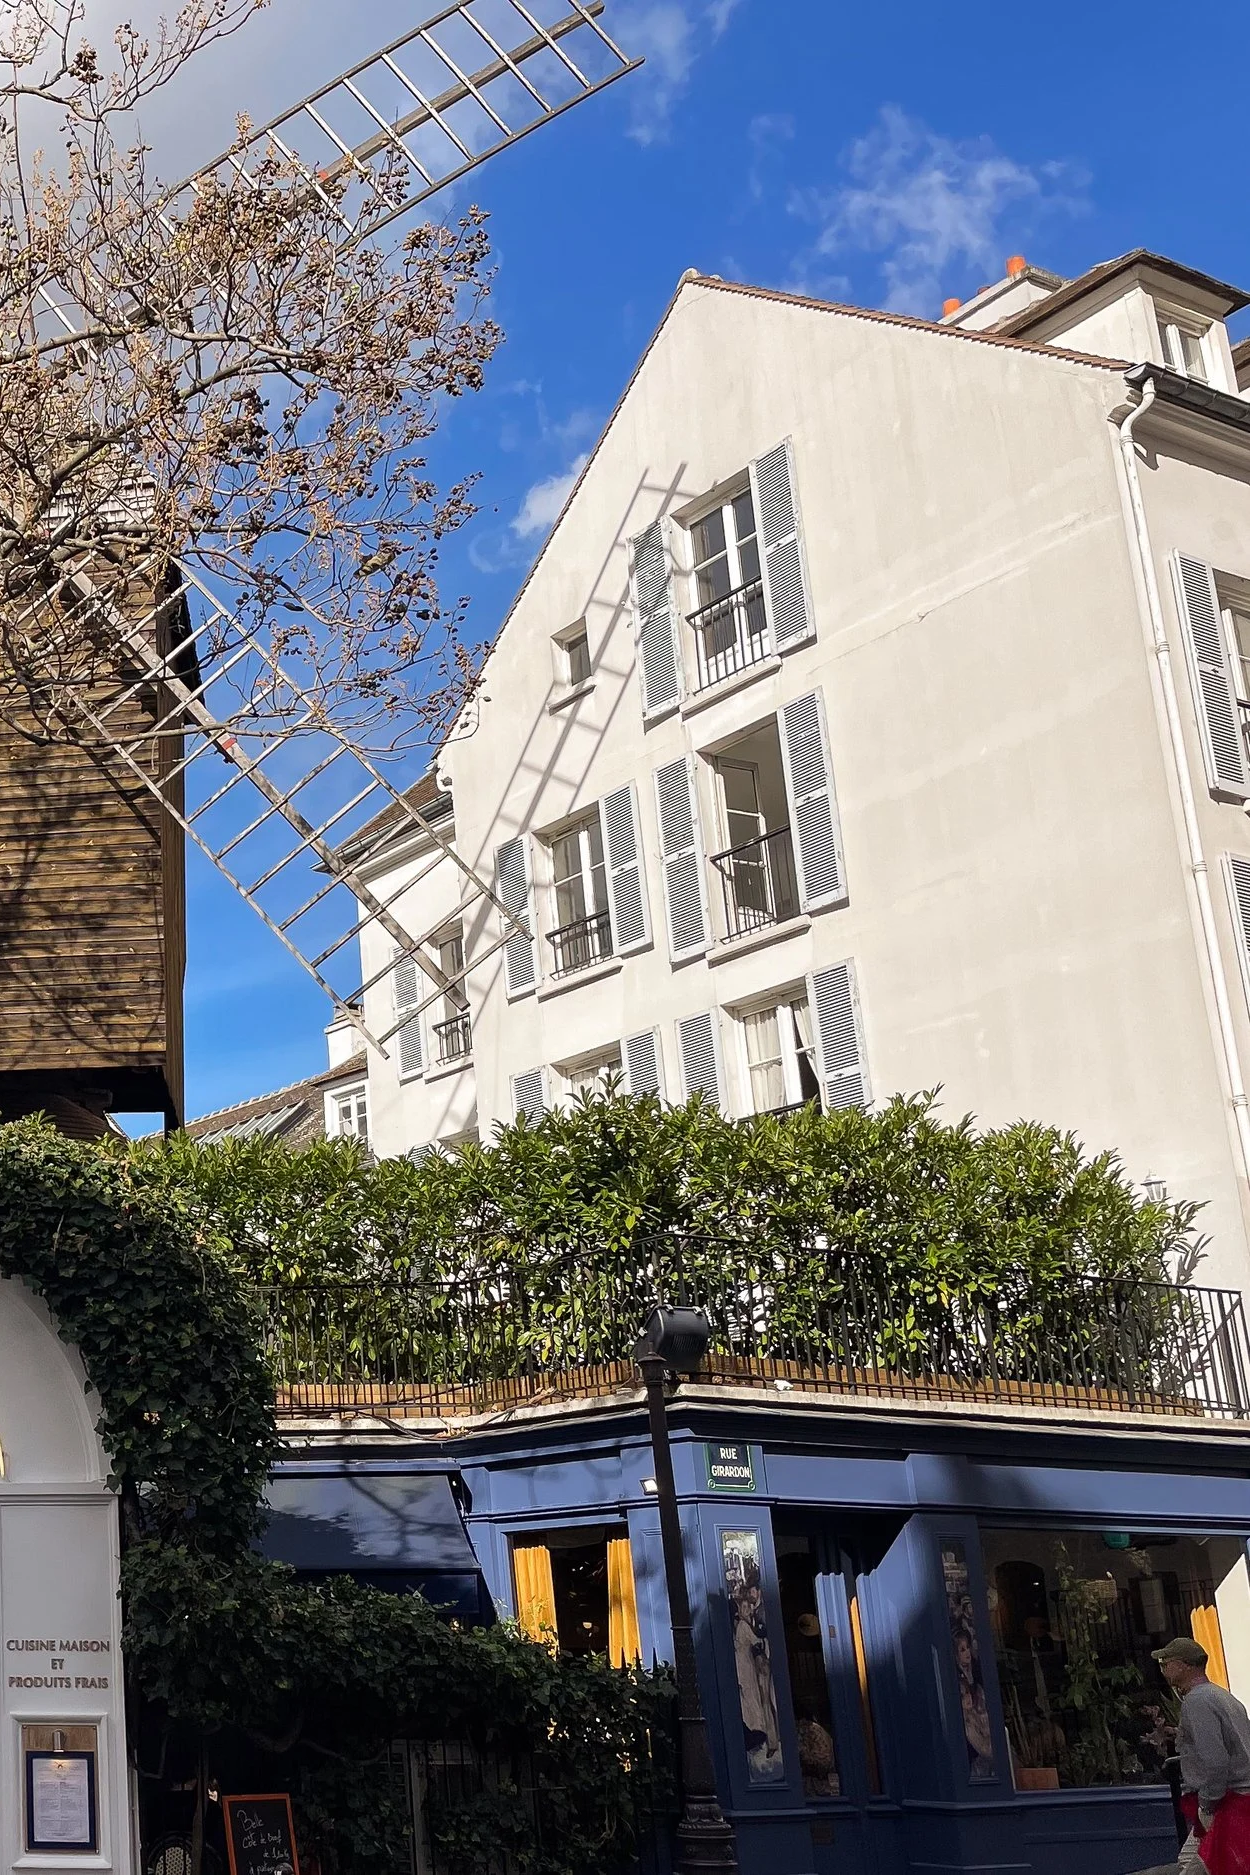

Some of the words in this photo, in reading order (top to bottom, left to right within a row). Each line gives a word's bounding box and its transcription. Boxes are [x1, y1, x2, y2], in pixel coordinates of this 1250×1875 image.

[719, 1447, 738, 1460] RUE
[711, 1464, 751, 1478] GIRARDON
[6, 1639, 57, 1652] CUISINE
[58, 1639, 110, 1652] MAISON
[51, 1658, 65, 1670] ET
[8, 1676, 72, 1689] PRODUITS
[74, 1676, 109, 1689] FRAIS
